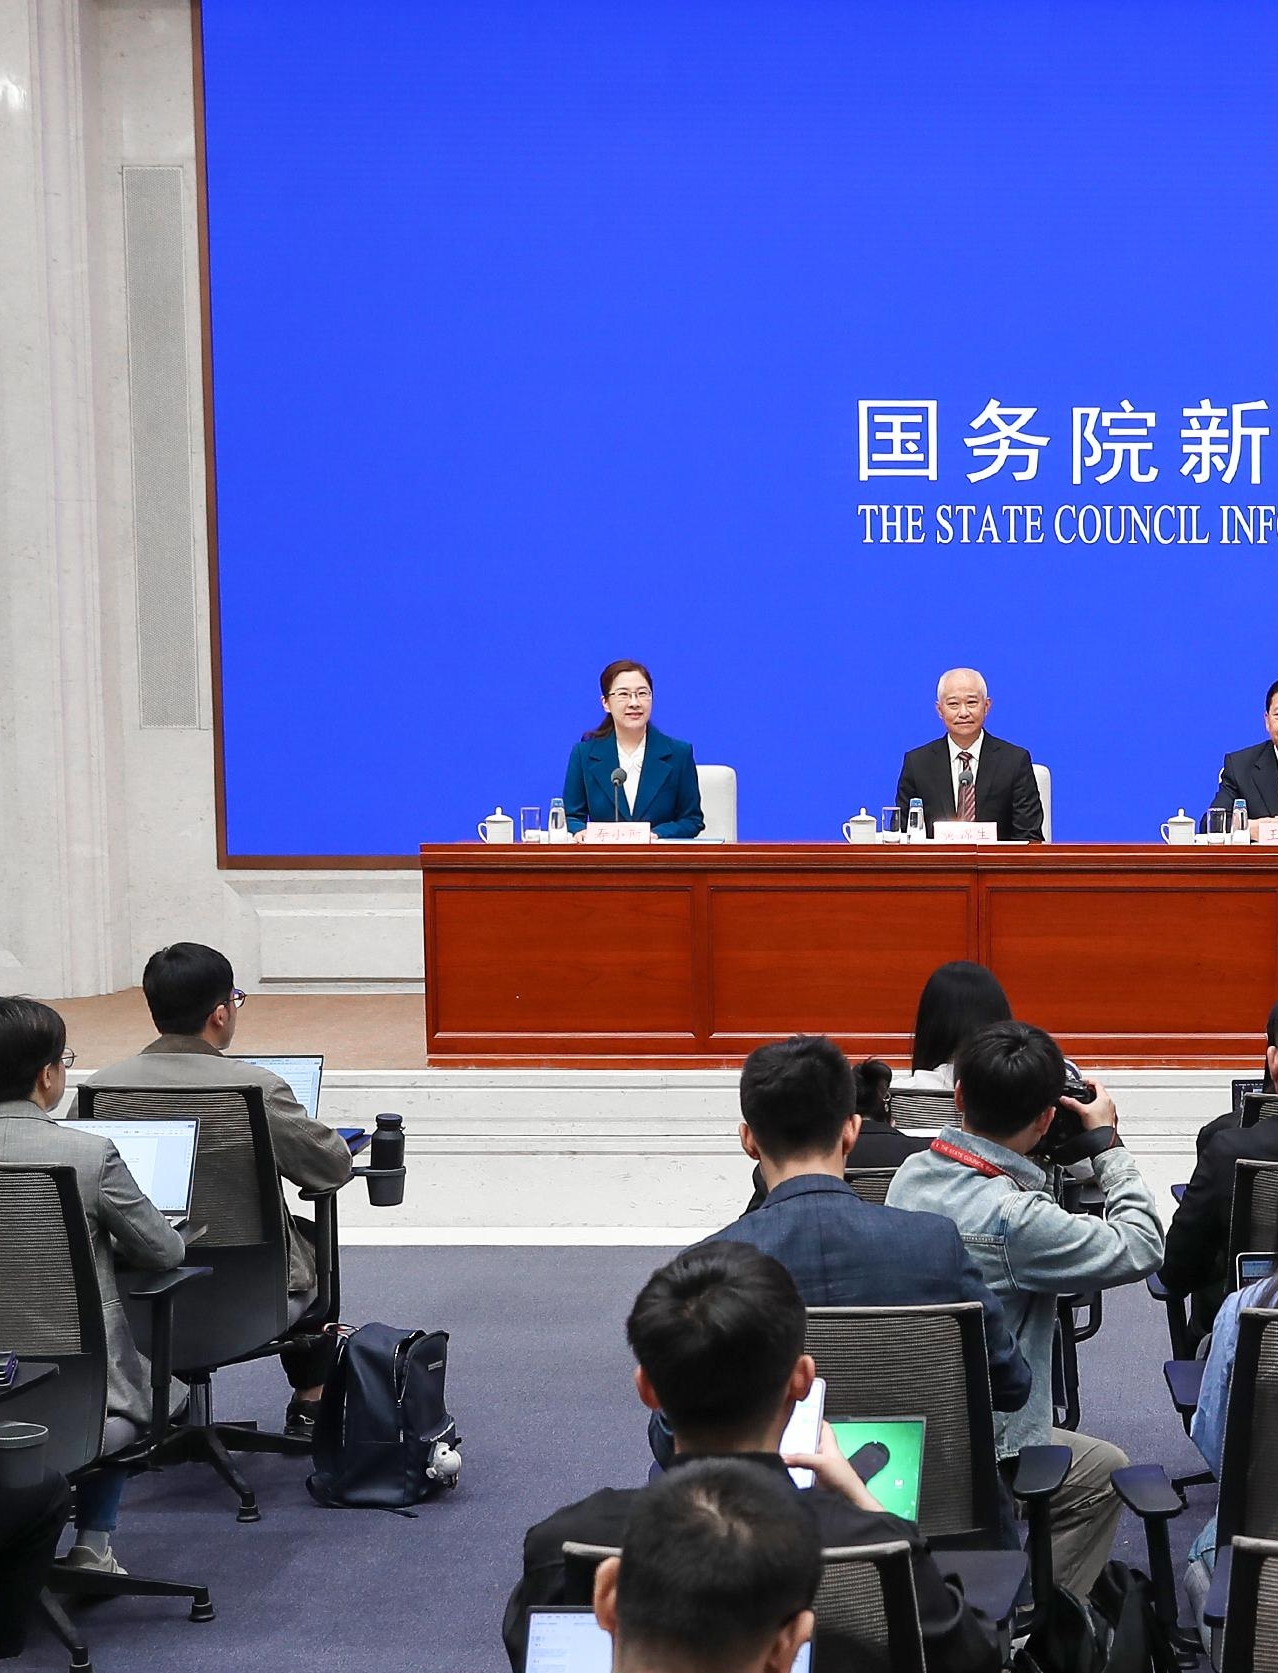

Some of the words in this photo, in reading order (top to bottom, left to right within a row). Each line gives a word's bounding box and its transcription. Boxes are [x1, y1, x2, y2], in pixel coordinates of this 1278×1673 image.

[857, 504, 926, 544] THE
[936, 504, 1045, 544] STATE
[1054, 504, 1210, 545] COUNCIL
